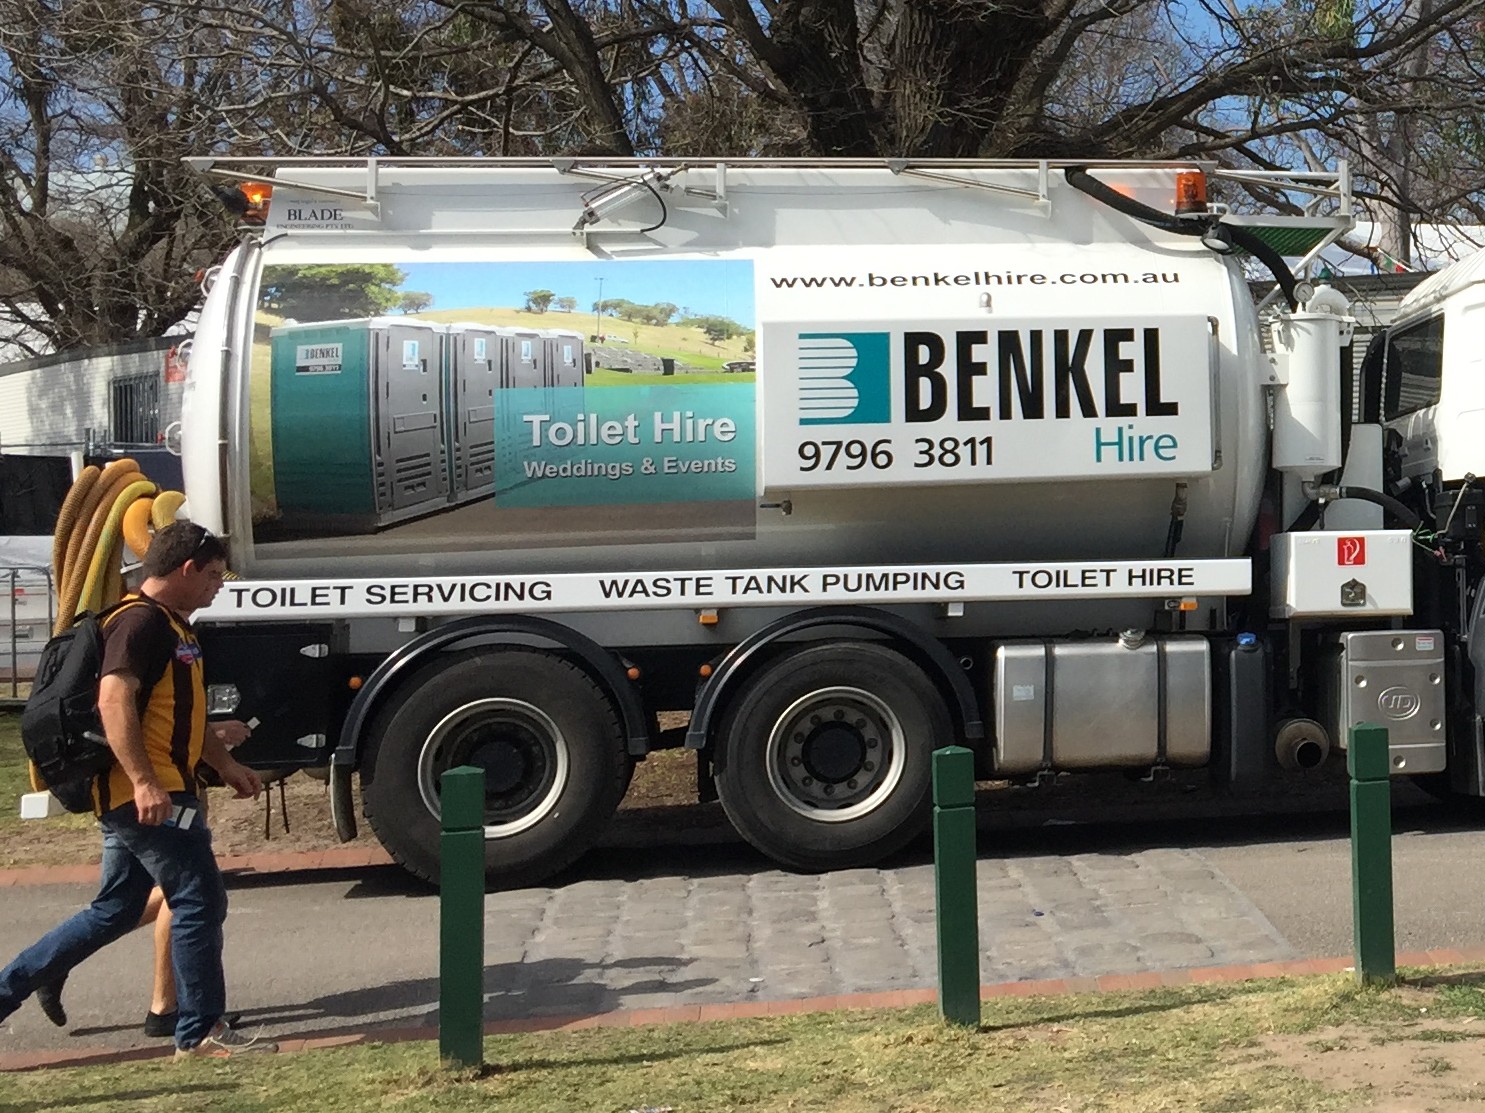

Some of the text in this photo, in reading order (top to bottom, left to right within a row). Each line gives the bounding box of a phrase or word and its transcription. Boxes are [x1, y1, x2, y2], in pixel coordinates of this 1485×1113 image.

[287, 208, 344, 221] BLADE
[769, 270, 1181, 290] www.benkelhire.com.au
[903, 327, 1180, 424] BENKEL
[523, 411, 737, 447] Toilet Hire
[797, 423, 1179, 473] 9796 3811 Hire
[523, 455, 738, 481] Weddings & Events
[228, 567, 1195, 609] TOILET SERVICING WASTE TANK PUMPING TOILET HIRE
